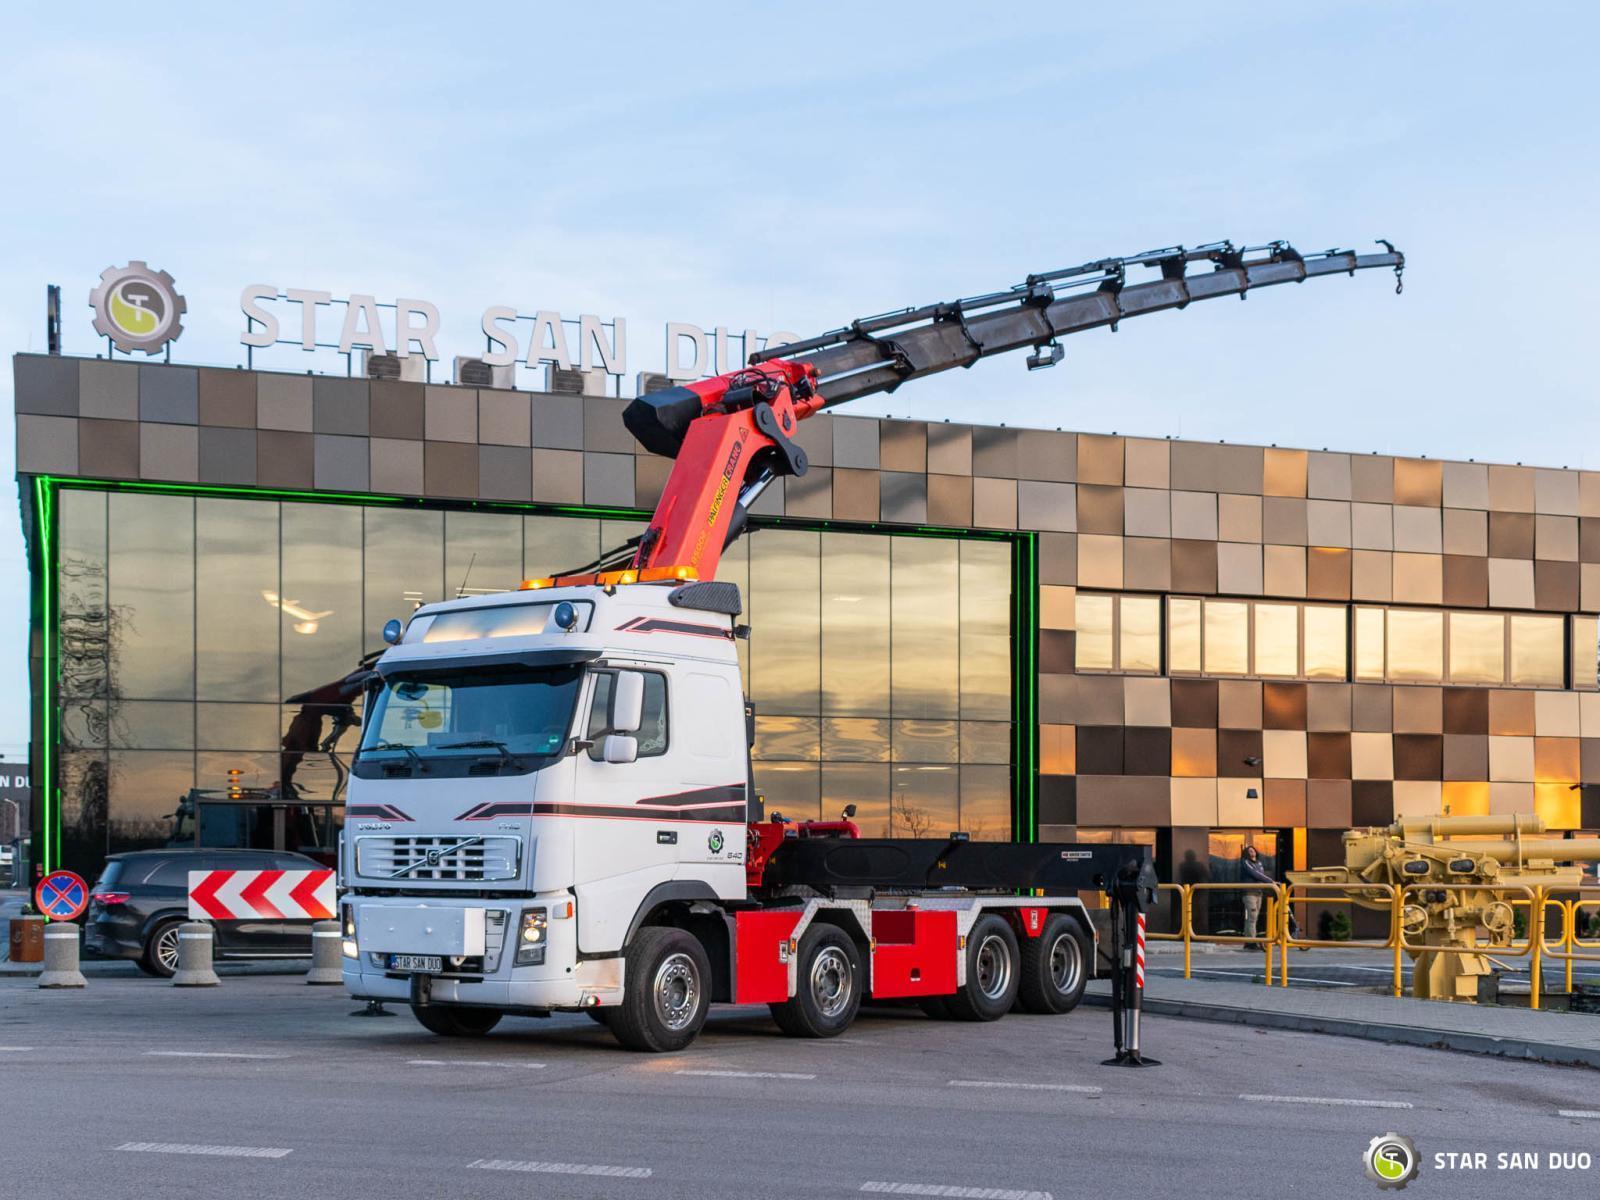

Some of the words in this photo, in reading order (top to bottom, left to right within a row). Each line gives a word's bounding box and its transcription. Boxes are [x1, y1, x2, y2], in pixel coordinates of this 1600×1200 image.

[240, 284, 441, 361] STAR
[481, 305, 627, 375] SAN
[358, 822, 392, 831] VOLVO
[396, 956, 411, 969] STAR
[412, 957, 426, 969] SAN
[427, 957, 441, 970] DUO
